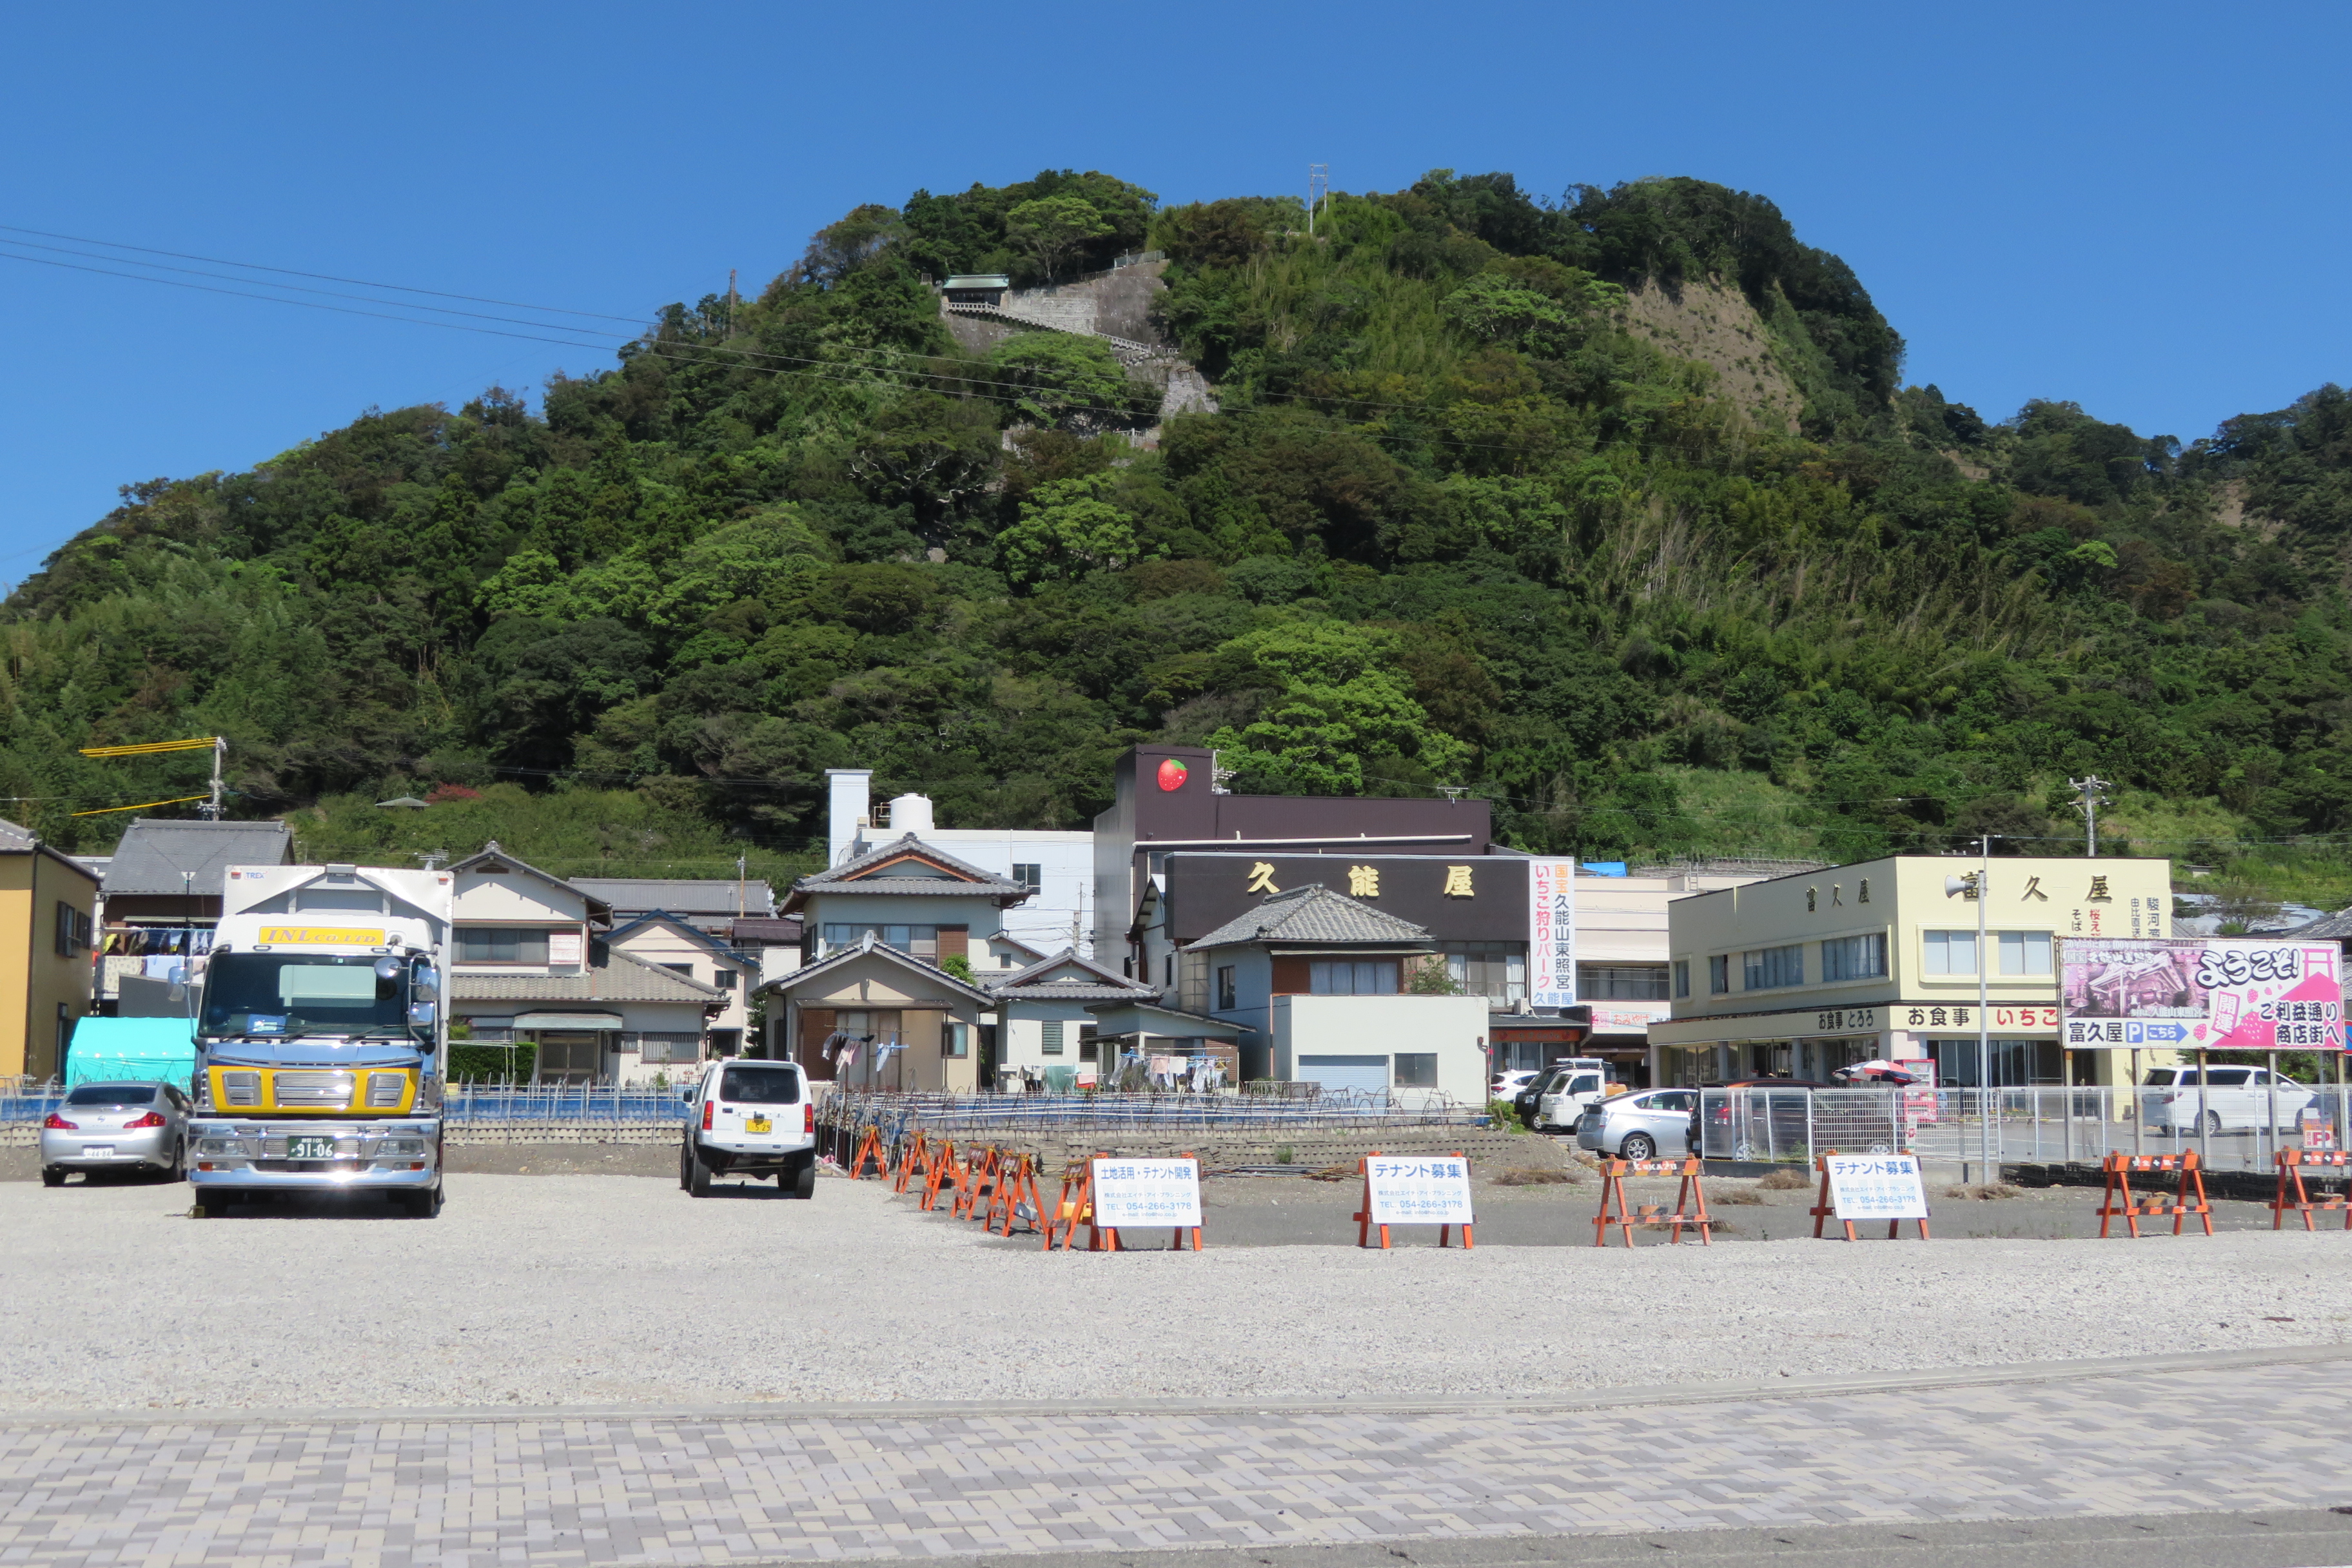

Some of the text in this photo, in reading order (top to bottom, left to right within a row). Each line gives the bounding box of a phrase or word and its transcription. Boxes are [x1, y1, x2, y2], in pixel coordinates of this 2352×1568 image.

[1248, 861, 1475, 897] 久能屋
[1536, 865, 1551, 988] いちご狩りパーク
[2071, 909, 2082, 936] そば
[2089, 908, 2101, 936] 桜え
[267, 929, 311, 941] INL
[1534, 992, 1574, 1005] 久能屋
[1818, 1009, 1874, 1030] お食事 とろろ
[1908, 1007, 2058, 1026] お食事 いちご
[2214, 992, 2238, 1034] 開運
[2260, 1001, 2338, 1022] ご利益通り
[2069, 1021, 2122, 1043] 富久屋
[2149, 1026, 2177, 1038] こちら
[2276, 1024, 2340, 1044] 商店街へ
[297, 1143, 333, 1157] 91-06
[1101, 1166, 1191, 1179] 土地活用・テナント開発
[1375, 1163, 1462, 1178] テナント募集
[1834, 1161, 1914, 1175] テナント募集
